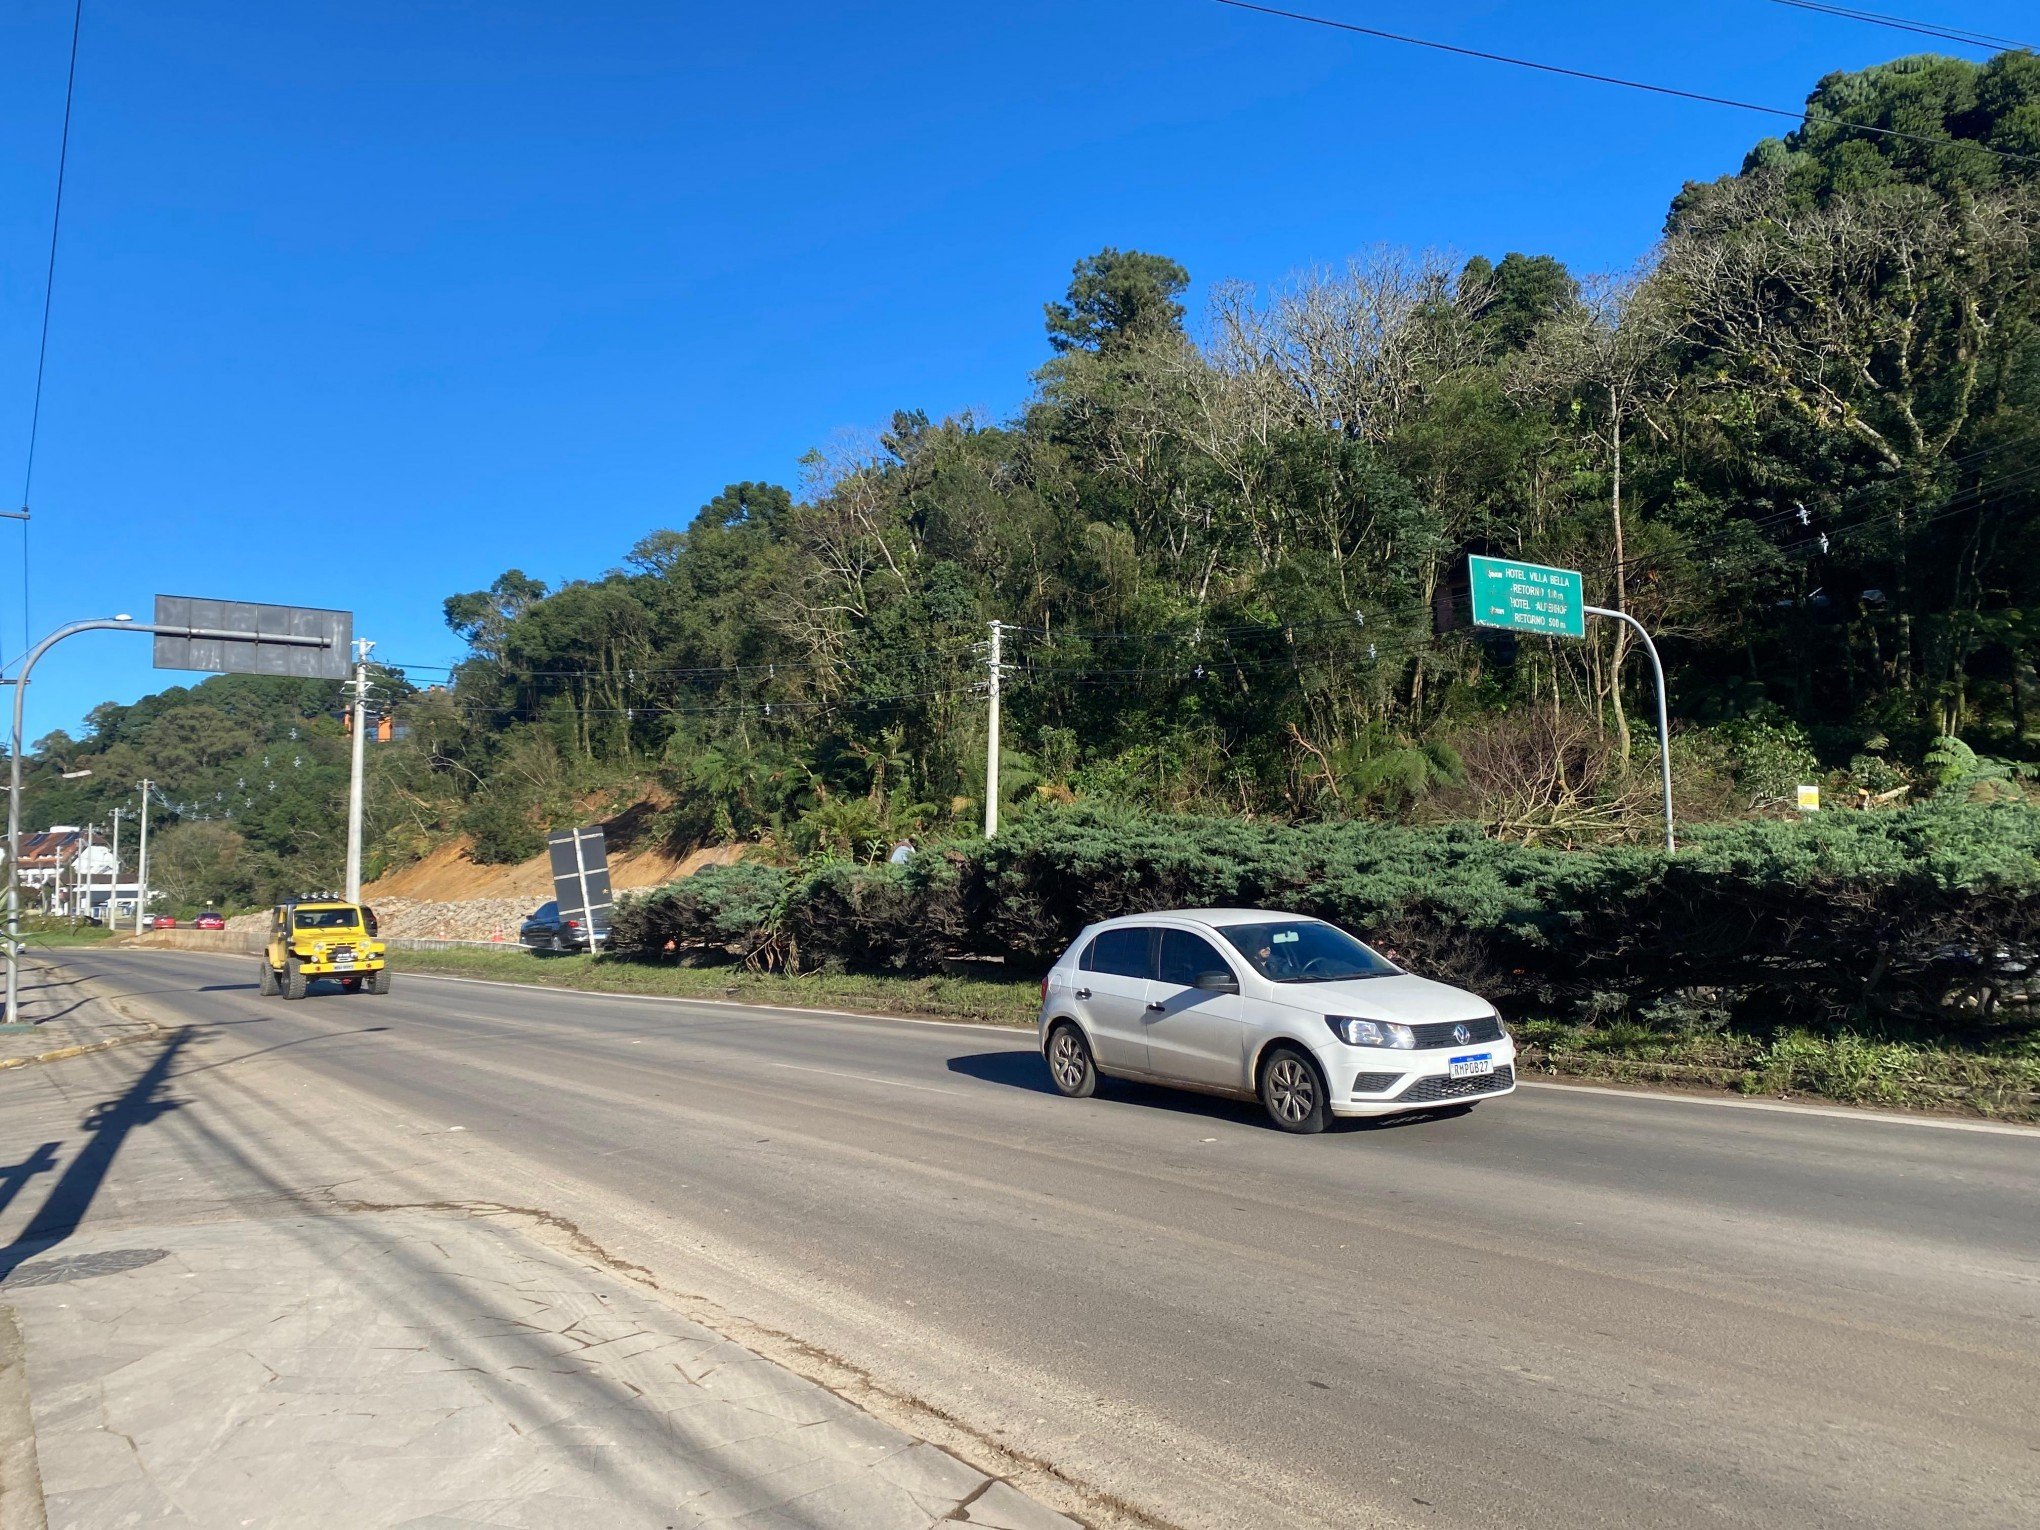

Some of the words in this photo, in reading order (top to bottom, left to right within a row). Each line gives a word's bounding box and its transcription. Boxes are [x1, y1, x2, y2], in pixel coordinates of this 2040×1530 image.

[1506, 568, 1526, 580] HOTEL
[1530, 572, 1547, 583] VILLA
[1550, 575, 1569, 587] BELLA
[1510, 597, 1531, 610] HOTEL
[1514, 613, 1545, 625] RETORNO
